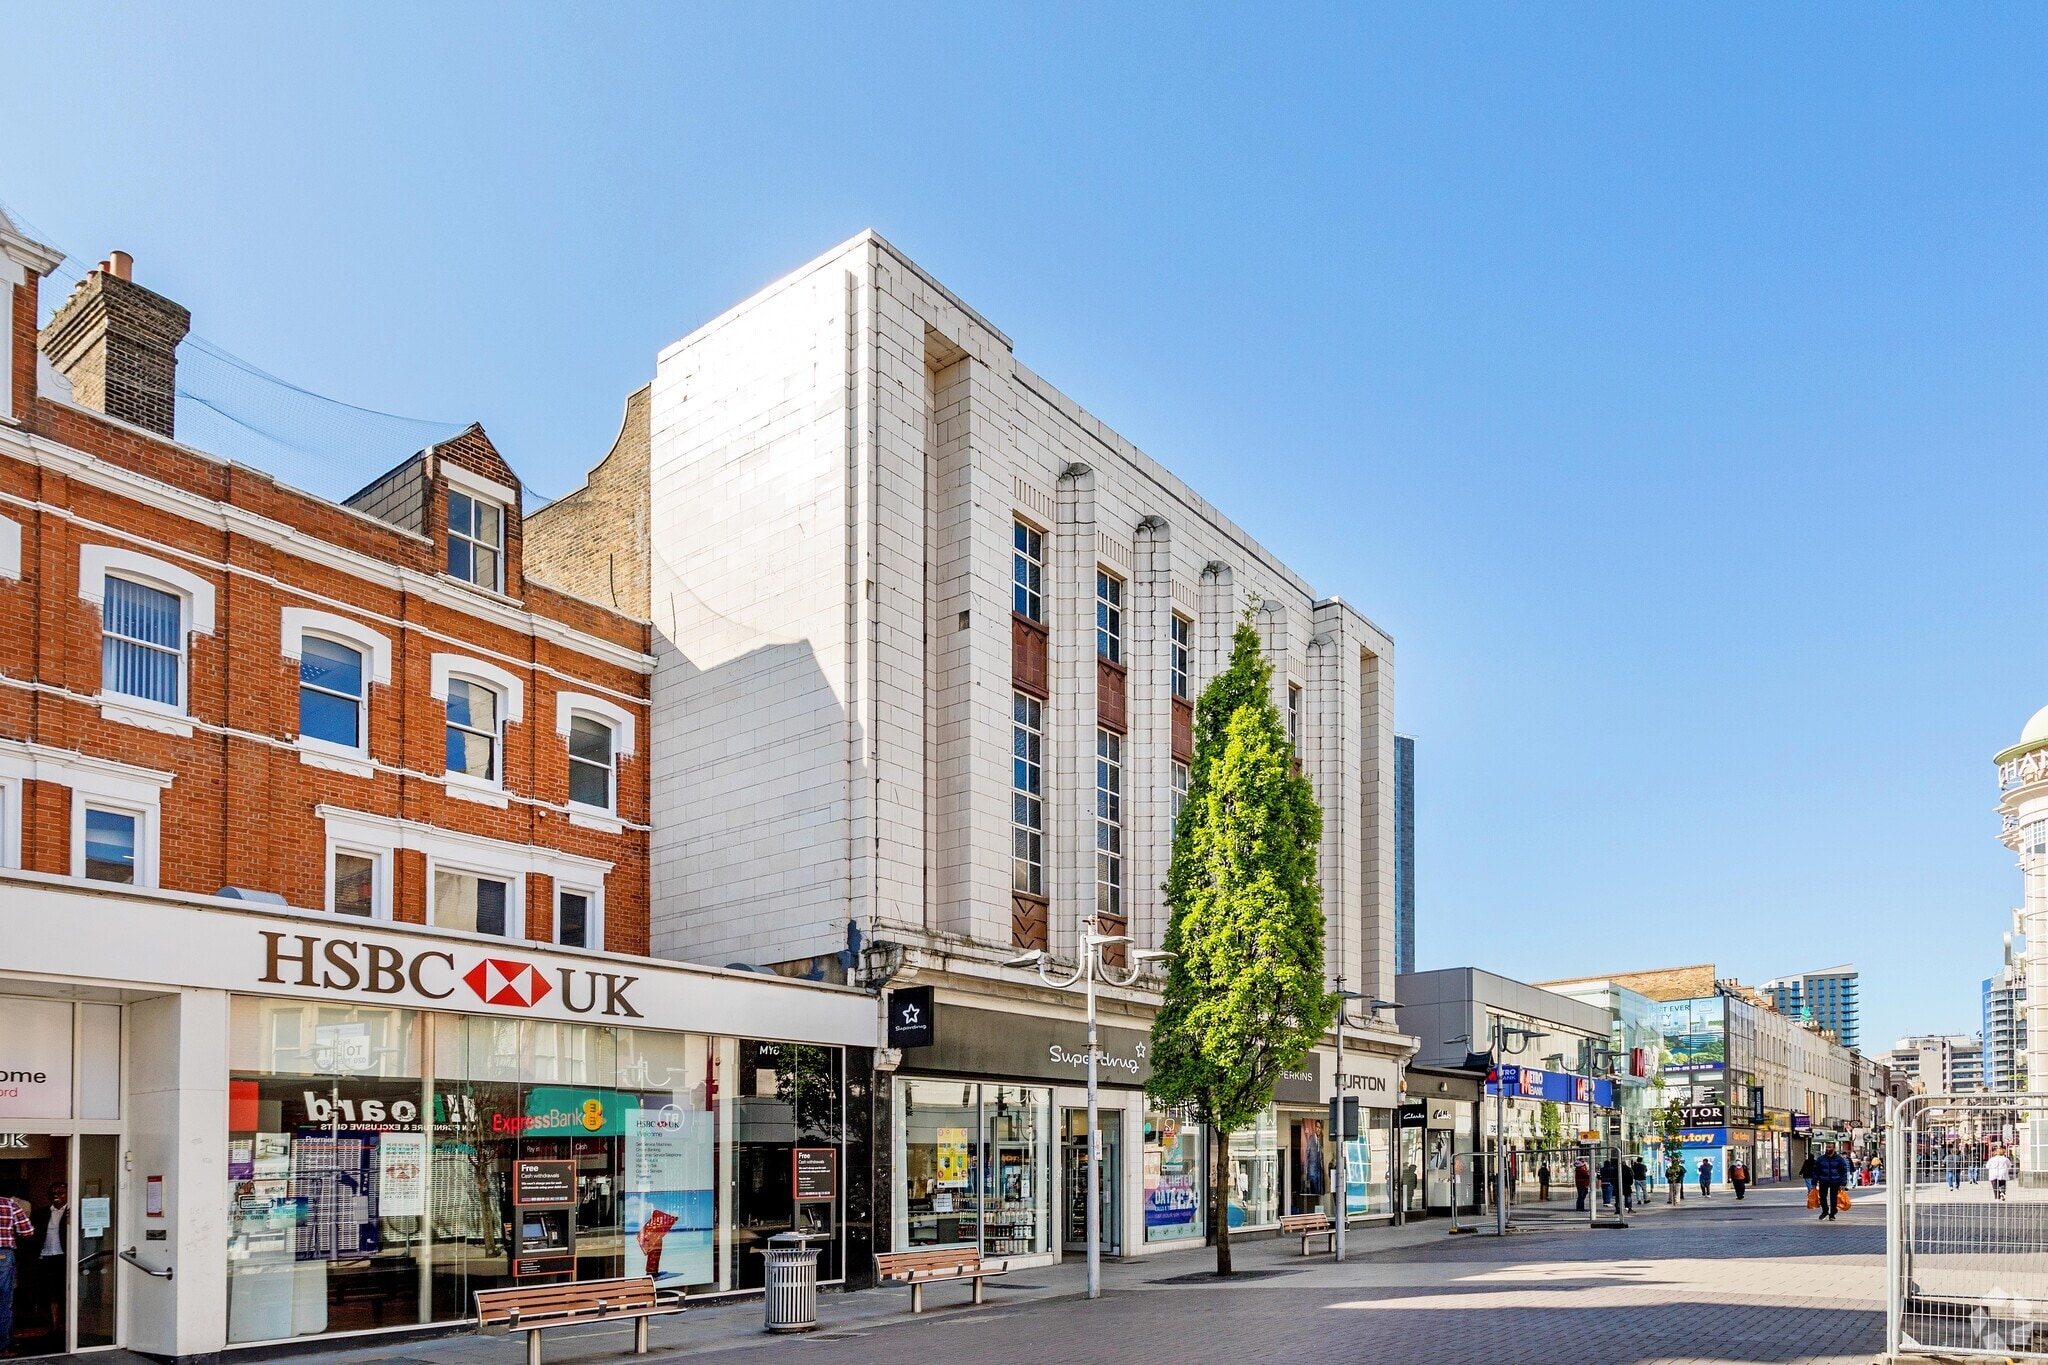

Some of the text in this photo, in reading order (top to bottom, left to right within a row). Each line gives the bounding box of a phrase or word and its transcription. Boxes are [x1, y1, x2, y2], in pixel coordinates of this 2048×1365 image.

[257, 930, 644, 1018] HSBC UK
[895, 1023, 927, 1032] Superdrug
[1050, 1045, 1139, 1073] Supedrug
[1334, 1074, 1386, 1092] URTON
[492, 1107, 584, 1135] ExpressBank
[1403, 1112, 1425, 1120] Clarks
[521, 1164, 539, 1172] Free
